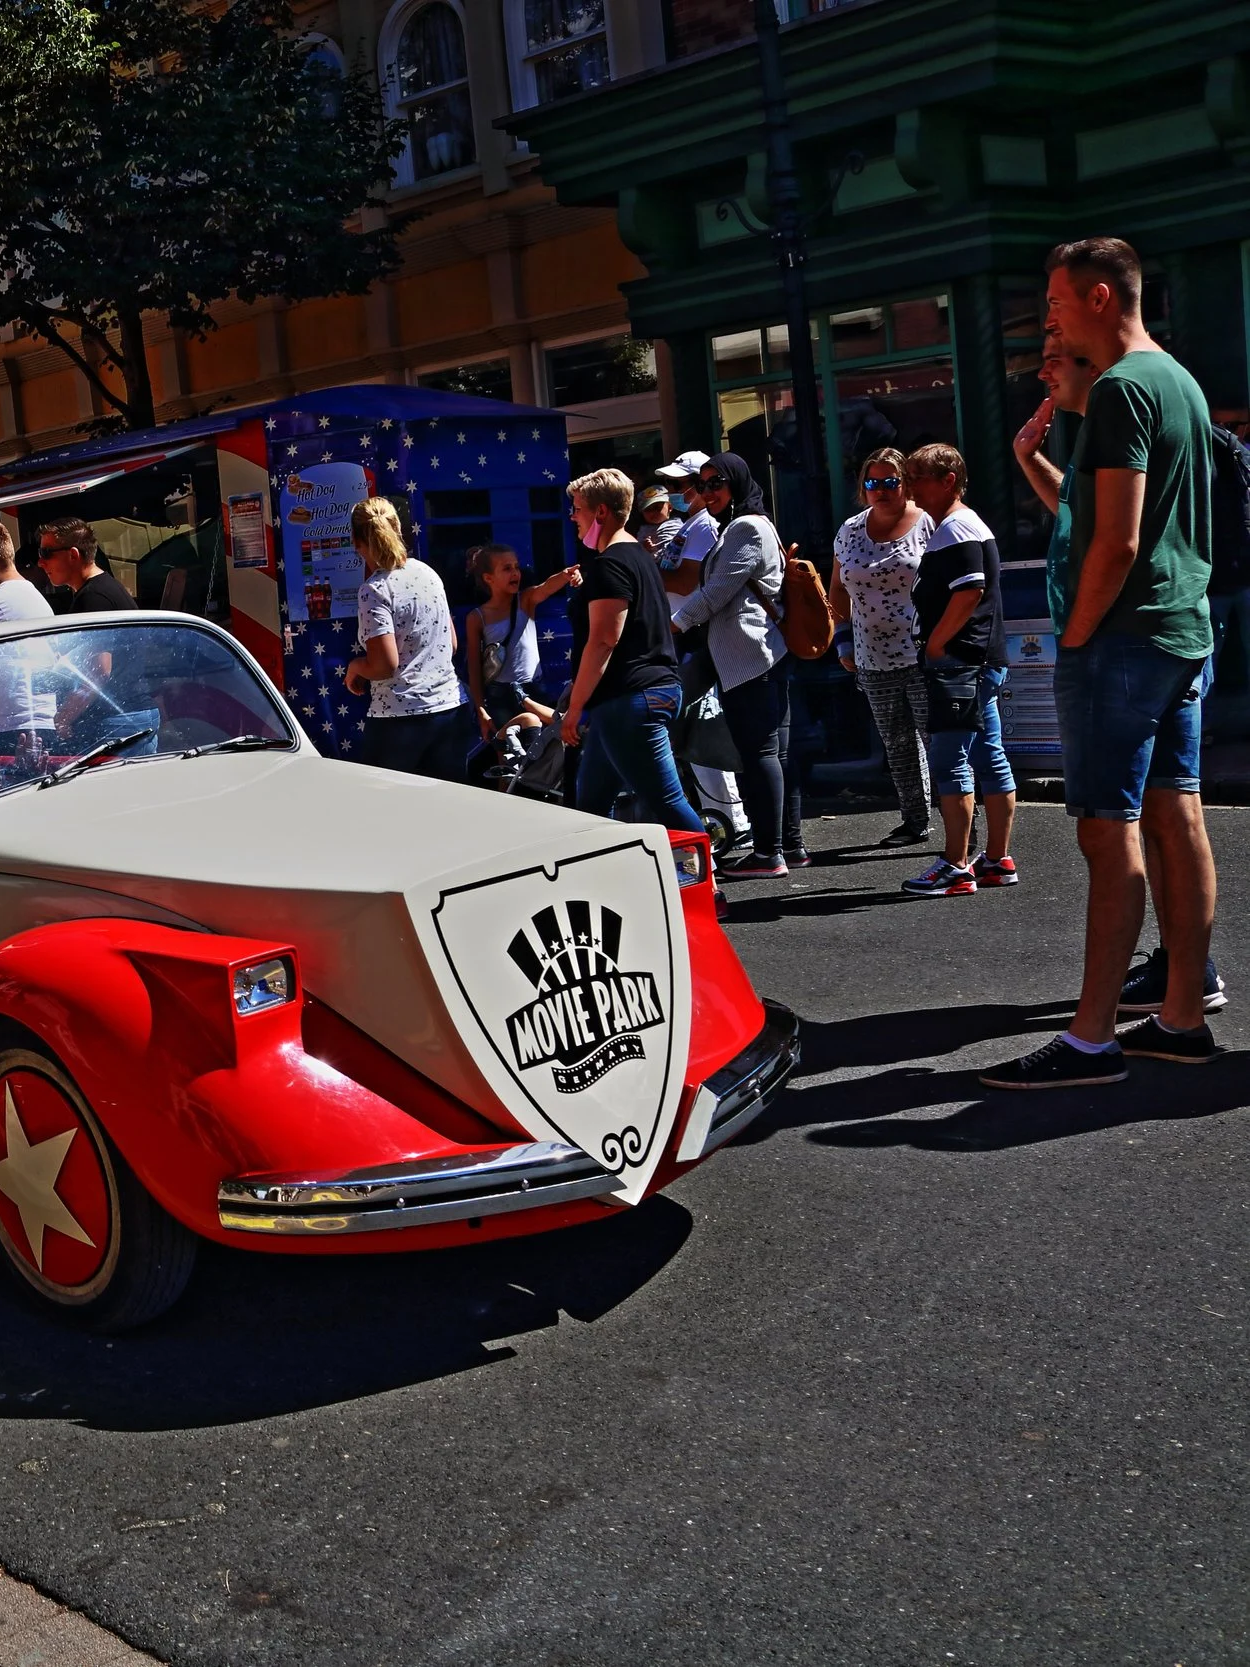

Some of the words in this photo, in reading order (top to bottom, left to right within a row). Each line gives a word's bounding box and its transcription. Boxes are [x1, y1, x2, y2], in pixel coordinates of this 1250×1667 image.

[296, 486, 316, 504] Hot
[316, 483, 336, 500] Dog
[310, 506, 328, 522] Hot
[329, 502, 350, 517] Dog
[303, 525, 325, 538] Cold
[325, 523, 351, 538] Drink
[513, 986, 596, 1065] MOVIE
[591, 976, 660, 1037] PARK
[558, 1044, 641, 1084] GERMANY
